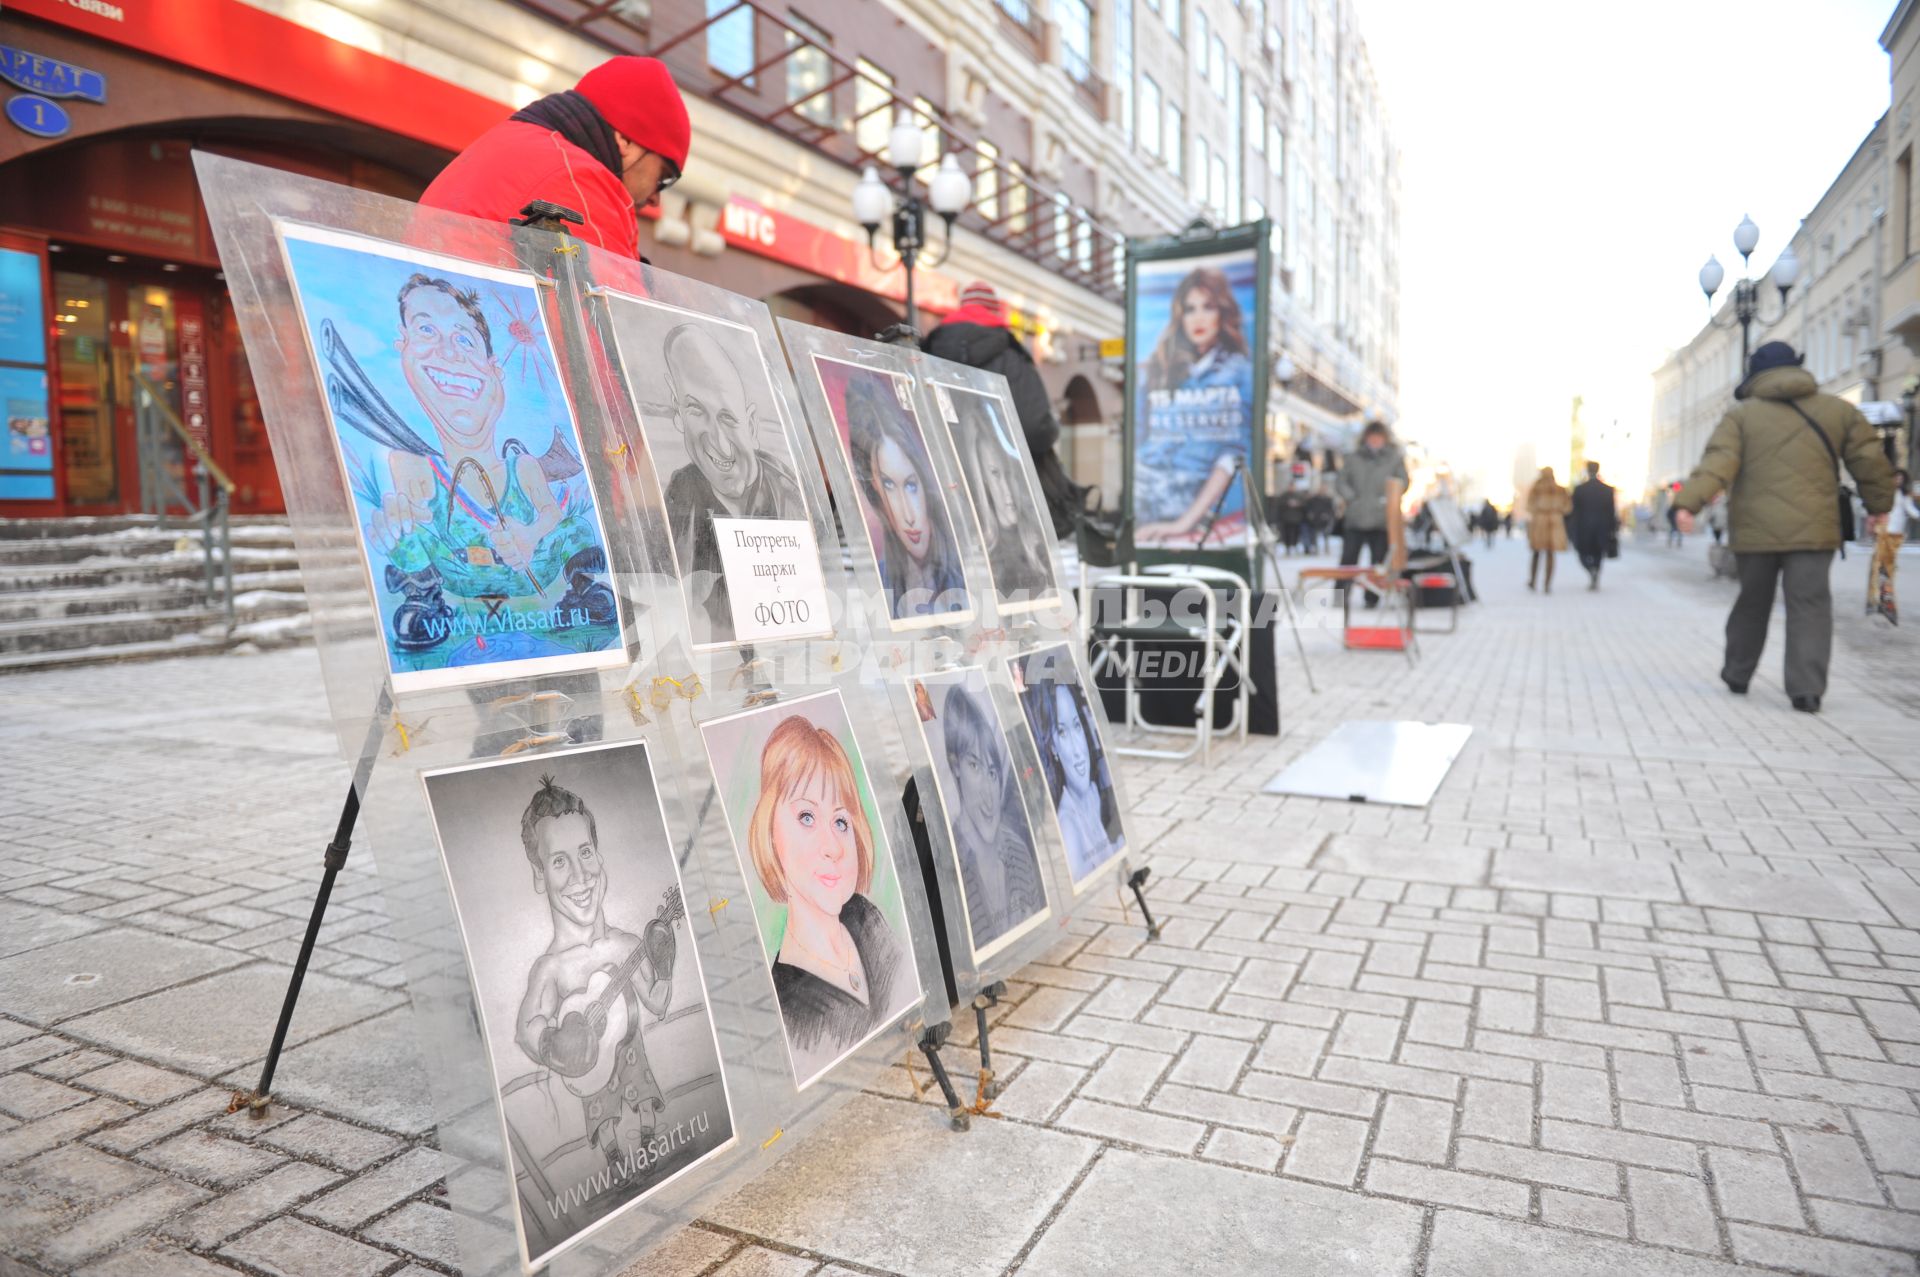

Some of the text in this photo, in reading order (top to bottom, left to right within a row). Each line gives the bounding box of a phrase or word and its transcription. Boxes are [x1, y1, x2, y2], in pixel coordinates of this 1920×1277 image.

[33, 104, 44, 125] 1
[725, 203, 777, 246] МТС
[1174, 386, 1242, 409] МАРТА
[1149, 411, 1243, 429] RESERVED
[734, 530, 801, 553] Портреты,
[752, 563, 797, 582] шаржи
[776, 585, 781, 593] с
[422, 606, 591, 639] www.vlasart.ru
[754, 599, 810, 626] ФОТО
[547, 1111, 709, 1220] www.vlasart.ru
